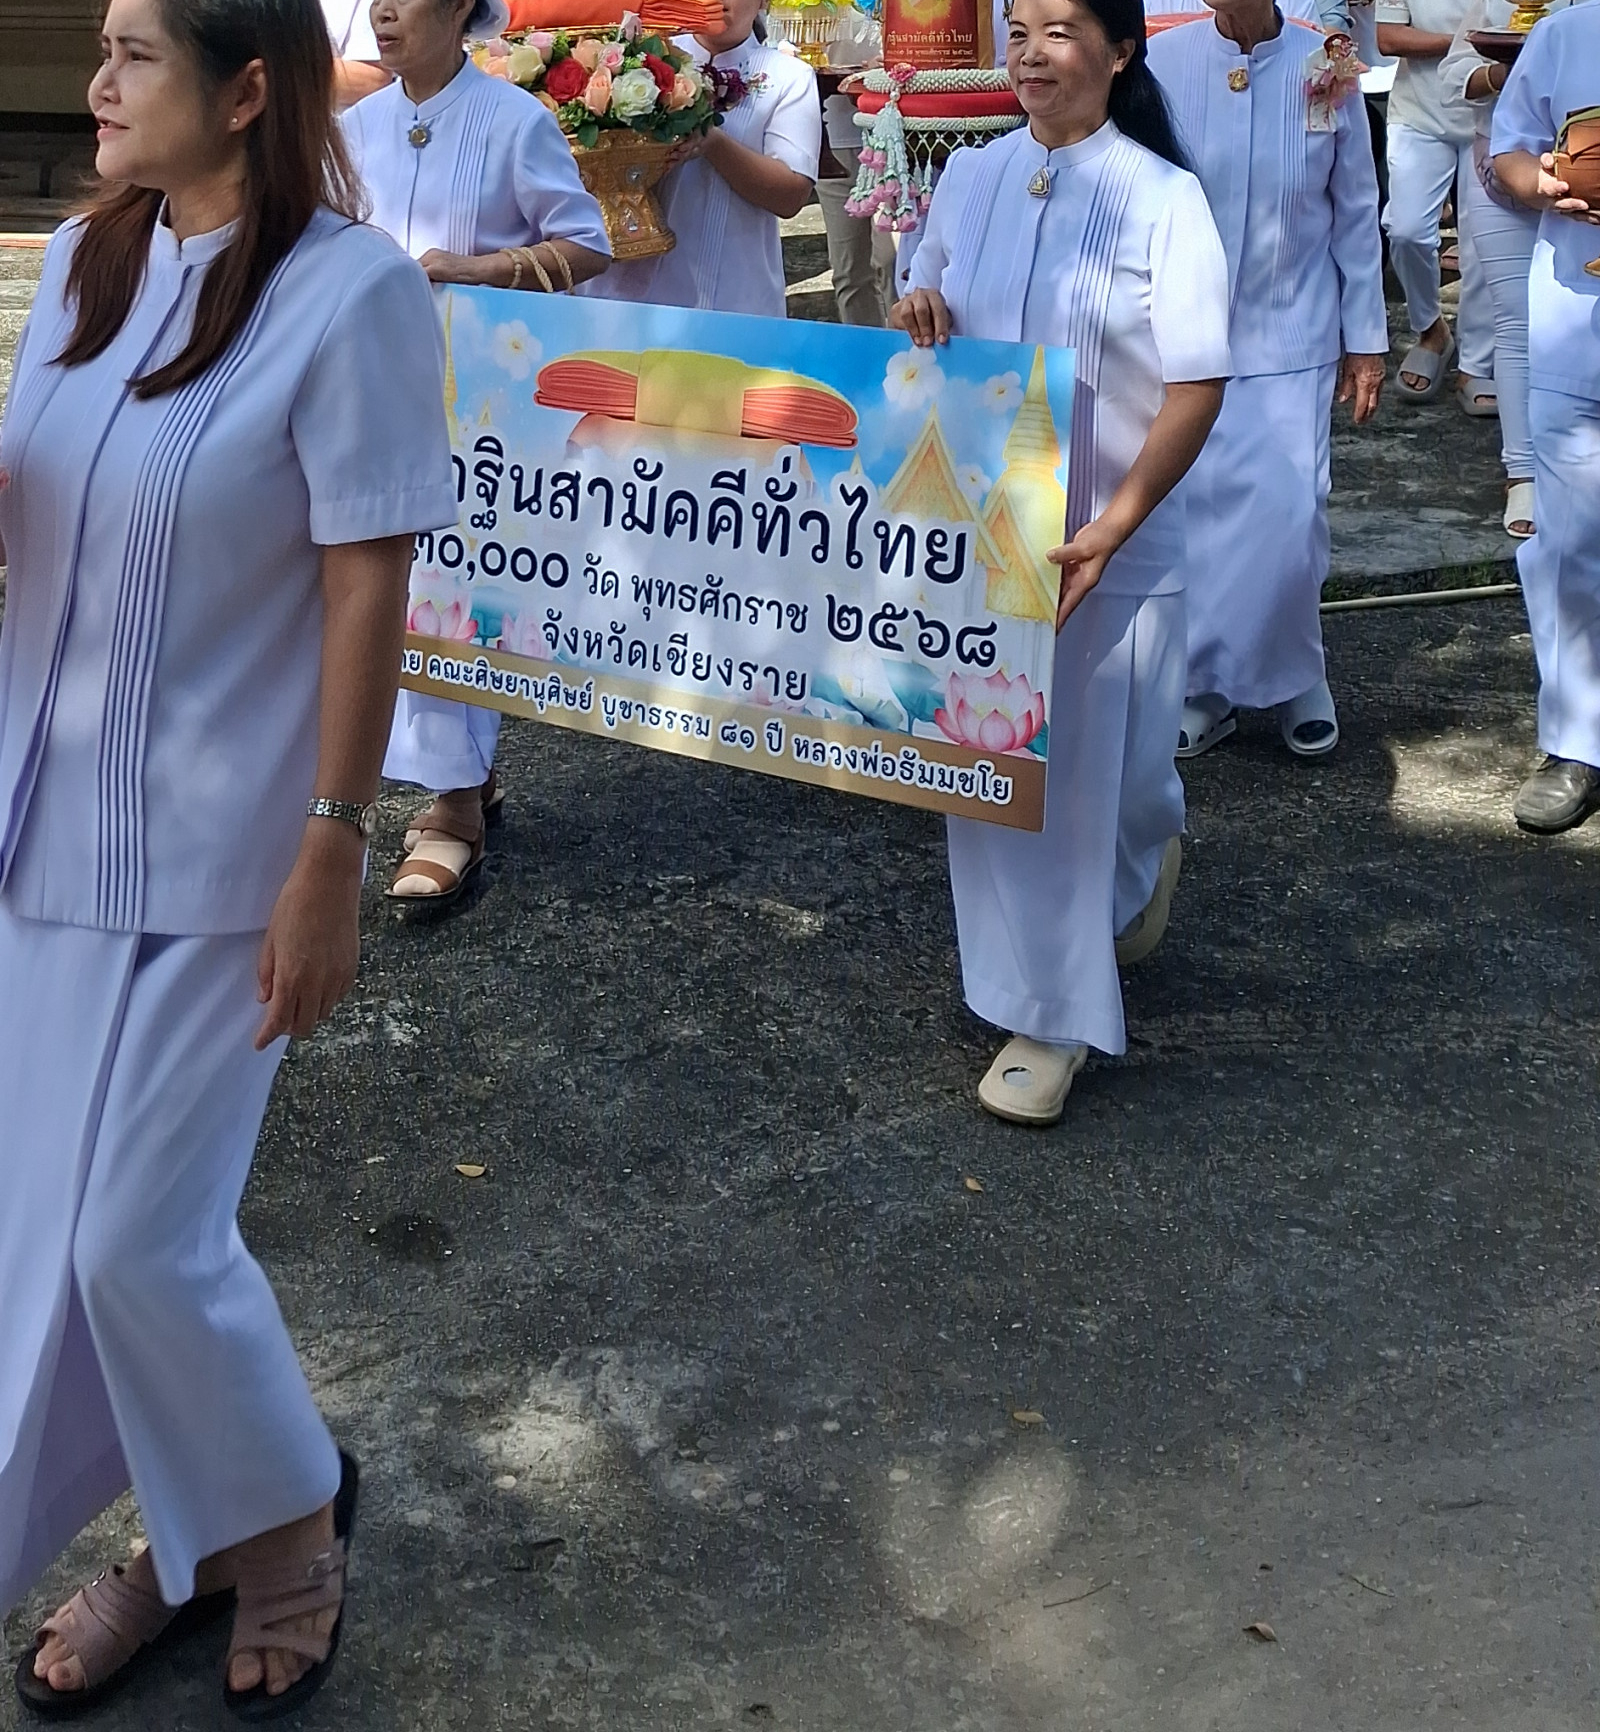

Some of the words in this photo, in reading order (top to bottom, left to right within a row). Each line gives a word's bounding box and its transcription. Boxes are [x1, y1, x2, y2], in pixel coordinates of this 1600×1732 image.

[542, 608, 807, 701] จังหวัดเชียงราย
[583, 552, 620, 599] วัด
[631, 574, 809, 634] พุทธศักราช
[825, 593, 998, 668] ๒๕๖๘
[428, 658, 594, 711] คณะศิษยานุศิษย์
[602, 695, 711, 737] บูชาธรรม
[721, 722, 755, 749] ๘๑
[766, 721, 784, 753] ปี
[794, 737, 1010, 801] หลวงพ่อธัมมชโย
